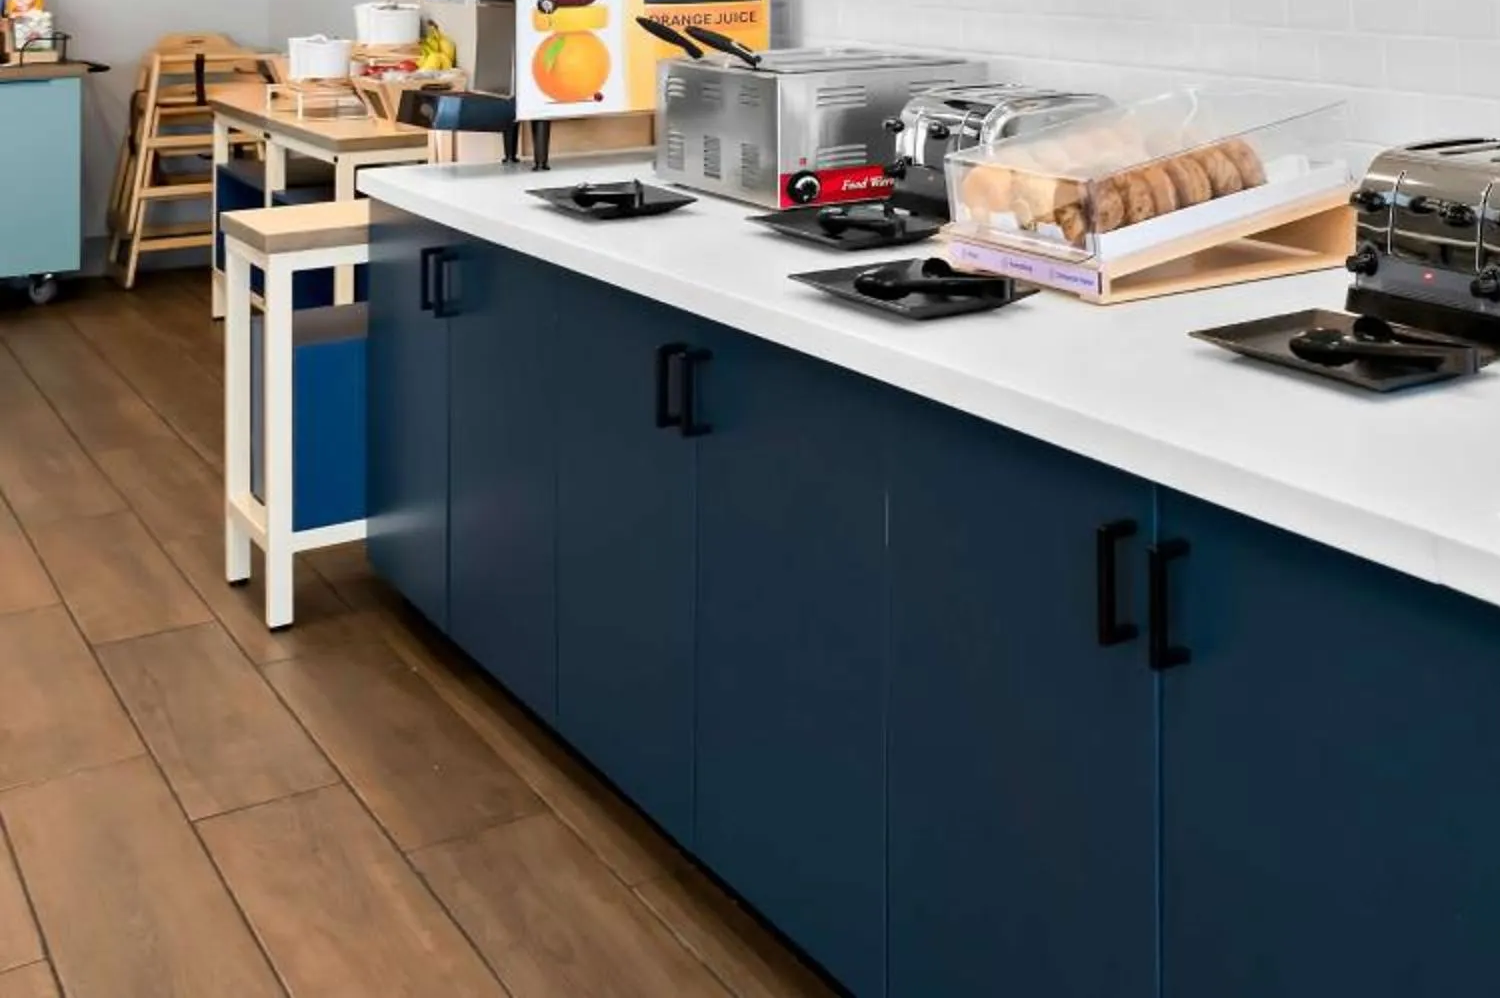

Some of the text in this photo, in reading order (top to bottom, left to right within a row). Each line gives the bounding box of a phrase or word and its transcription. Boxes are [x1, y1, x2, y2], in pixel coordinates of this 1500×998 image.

[650, 10, 757, 26] ORANGE JUICE
[841, 176, 868, 191] Food
